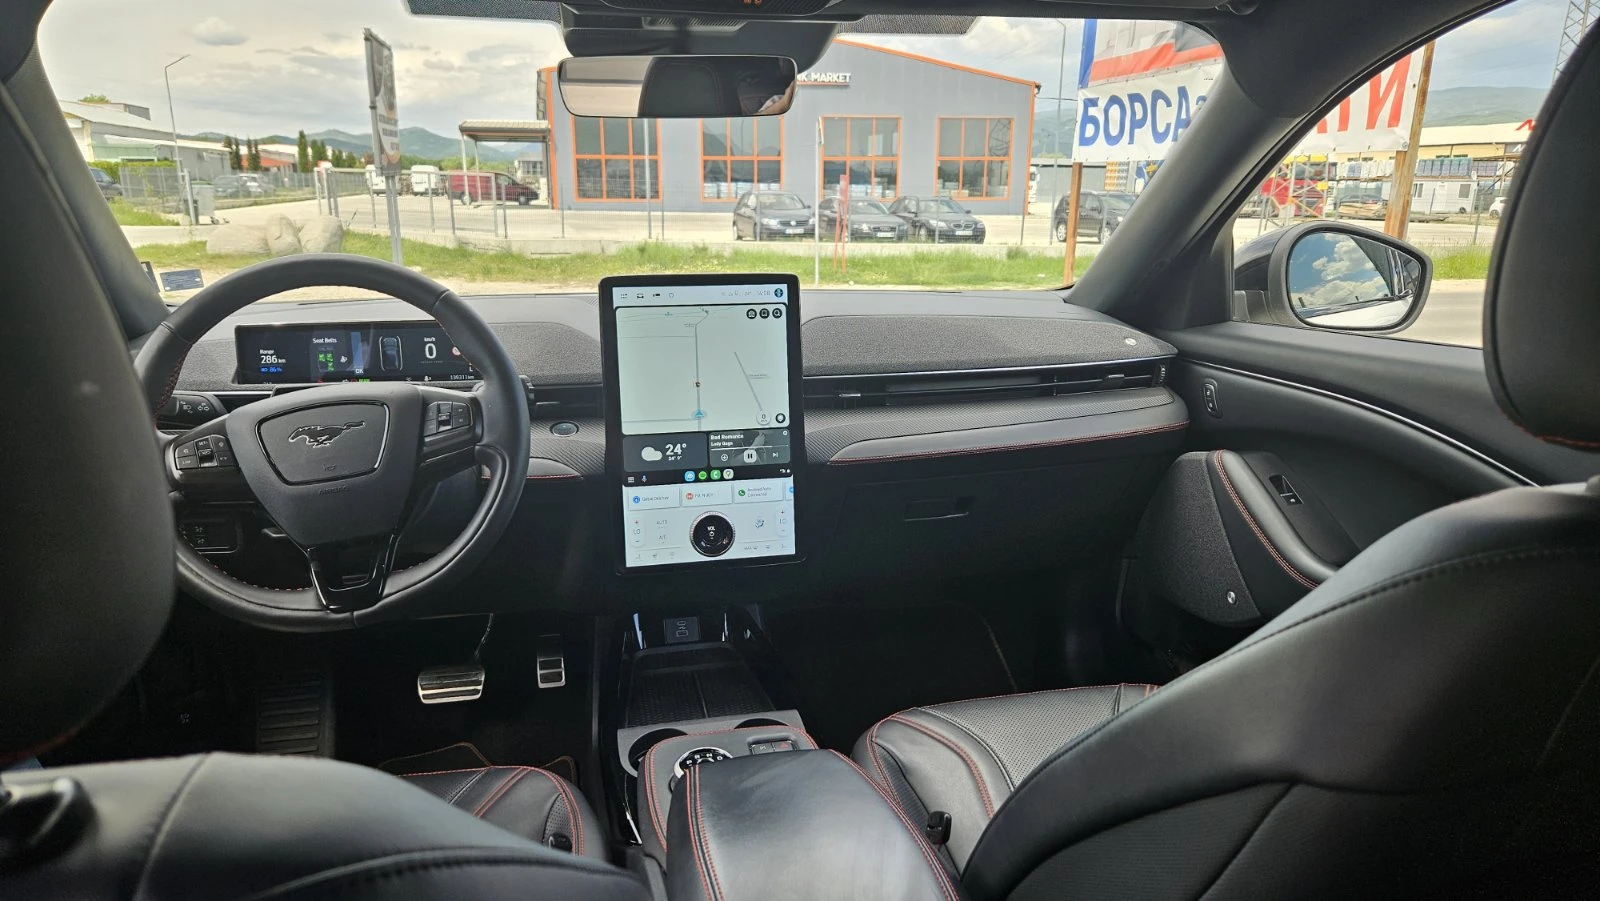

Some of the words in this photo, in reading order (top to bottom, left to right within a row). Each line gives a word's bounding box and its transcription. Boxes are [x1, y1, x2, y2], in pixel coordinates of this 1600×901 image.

[811, 72, 851, 83] MARKET
[1079, 86, 1191, 146] БОРСА
[425, 343, 437, 359] 0
[261, 355, 278, 364] 286
